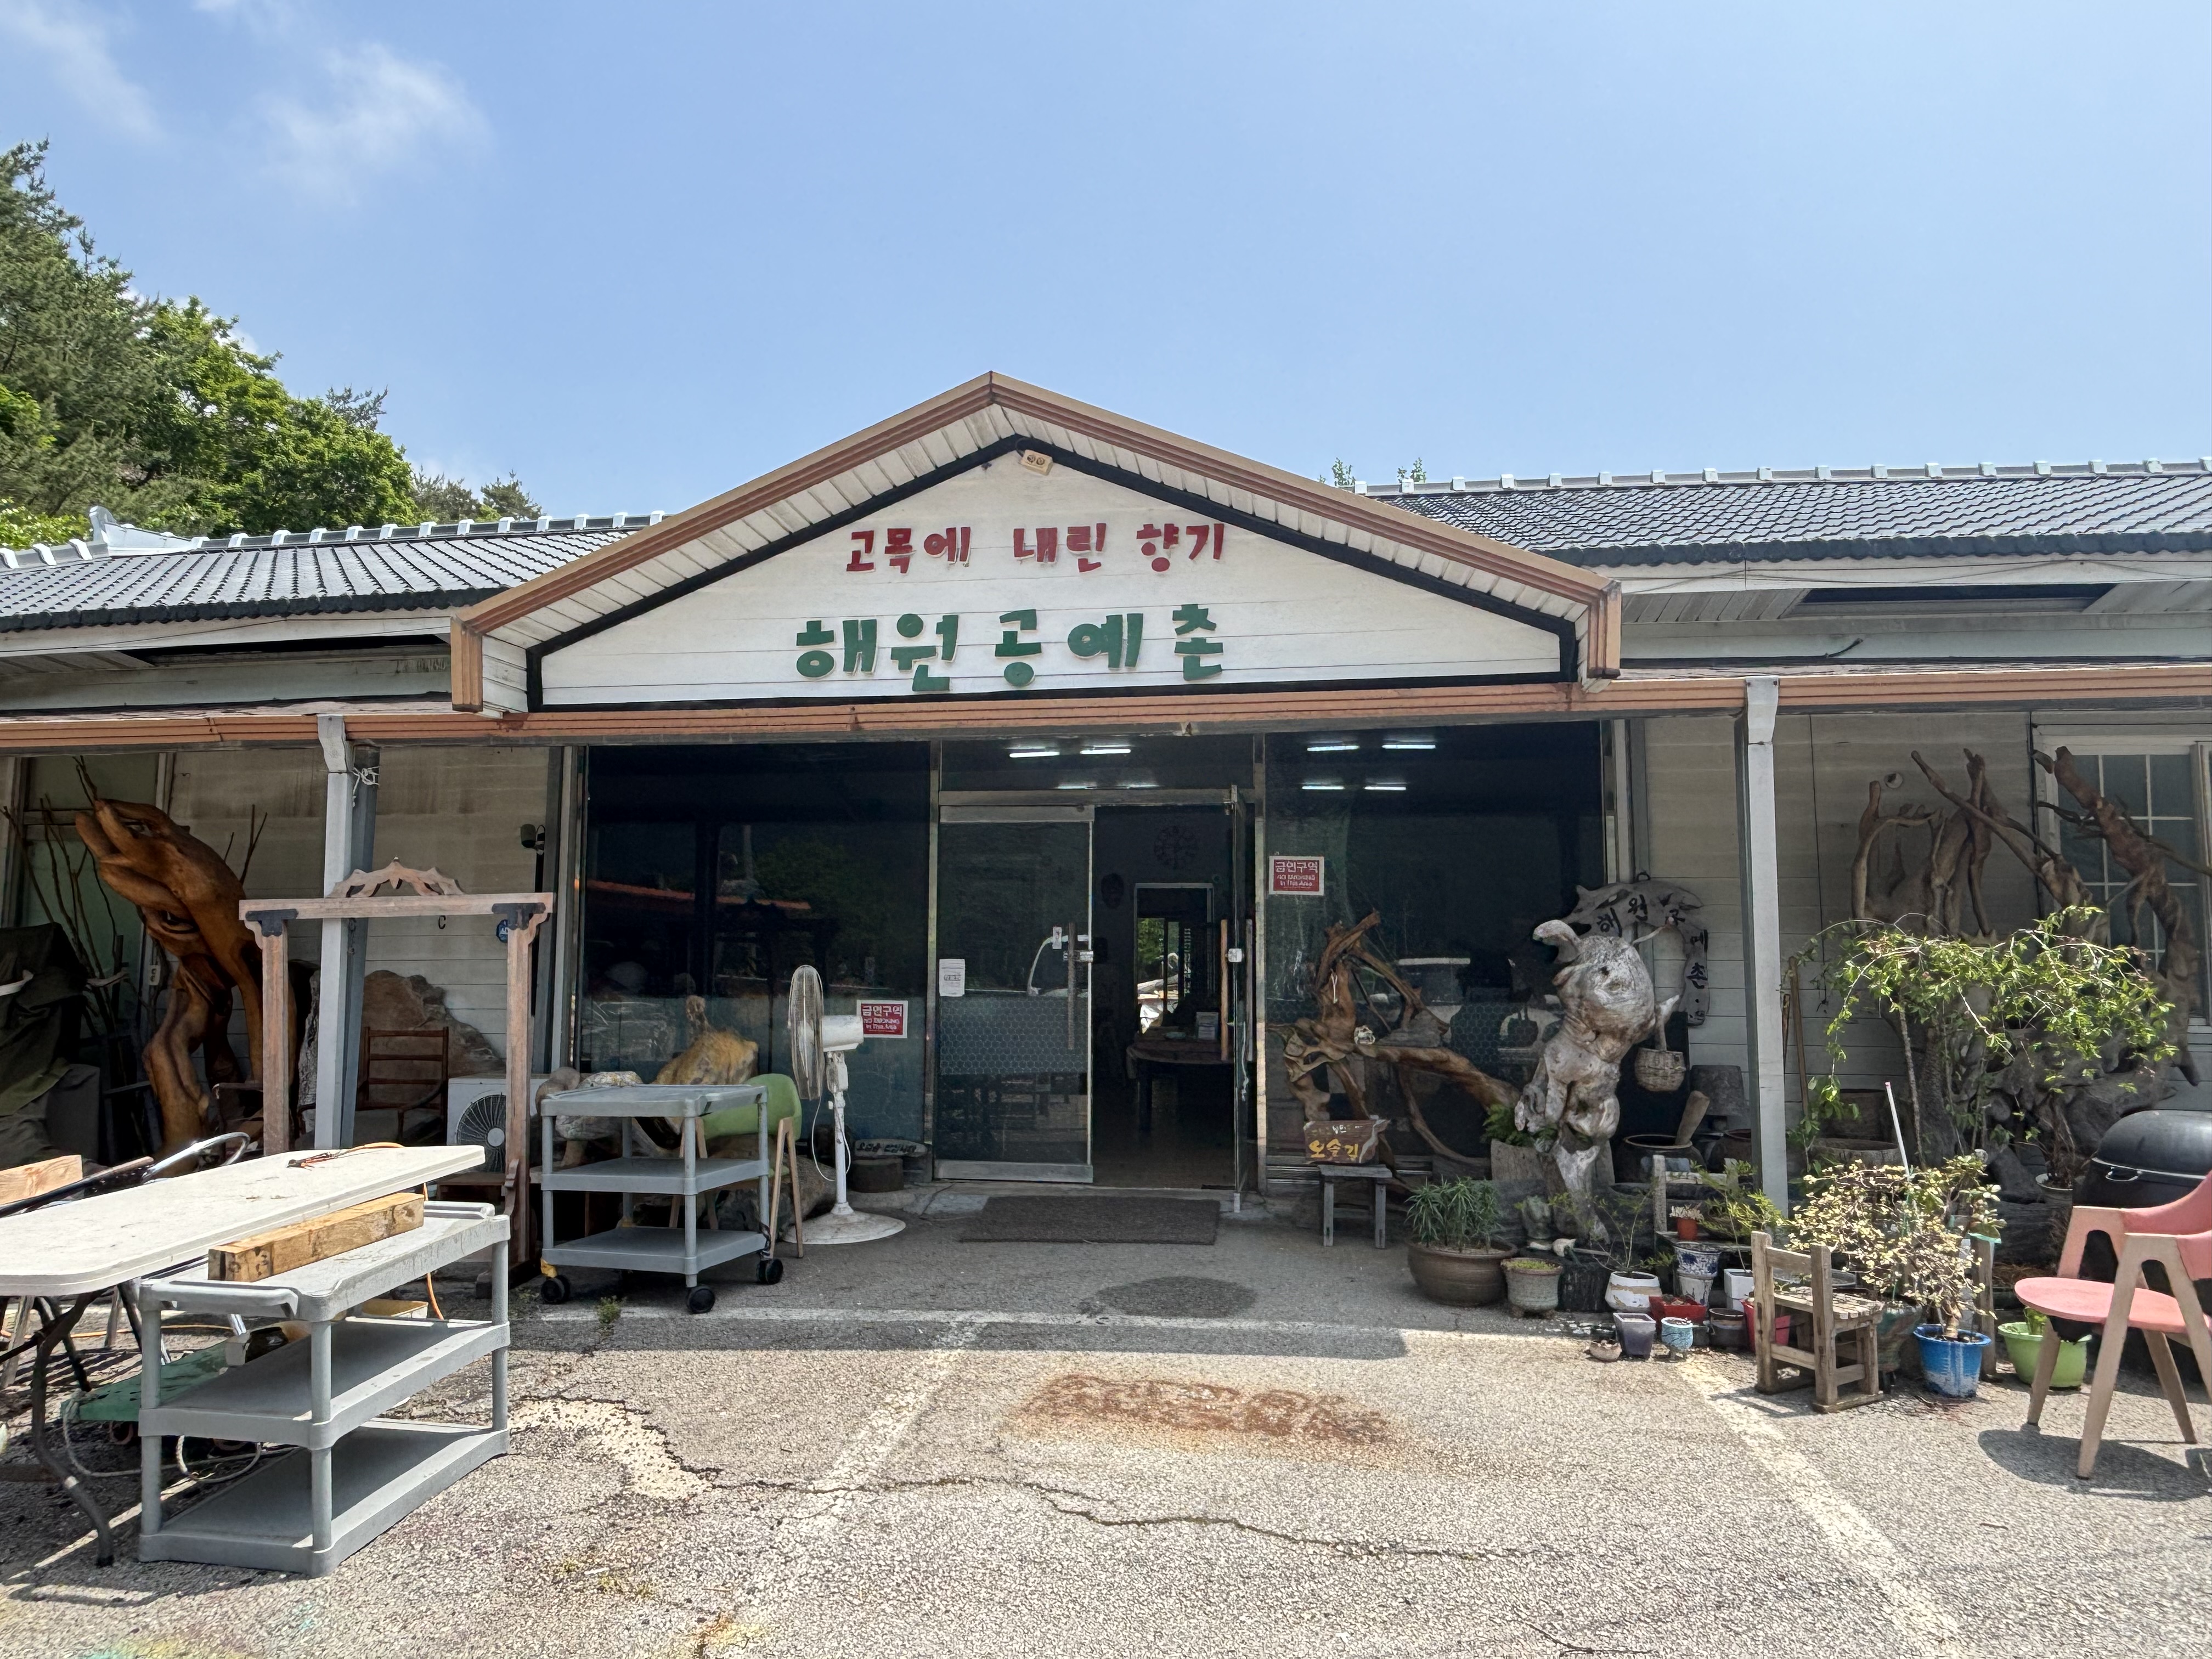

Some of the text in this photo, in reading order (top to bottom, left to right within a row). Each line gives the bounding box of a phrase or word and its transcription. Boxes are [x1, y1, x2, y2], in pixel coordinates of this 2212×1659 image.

[846, 523, 1224, 574] 고목에 내린 향기
[1275, 861, 1318, 873] 금연구역
[862, 1005, 902, 1017] 금연구역
